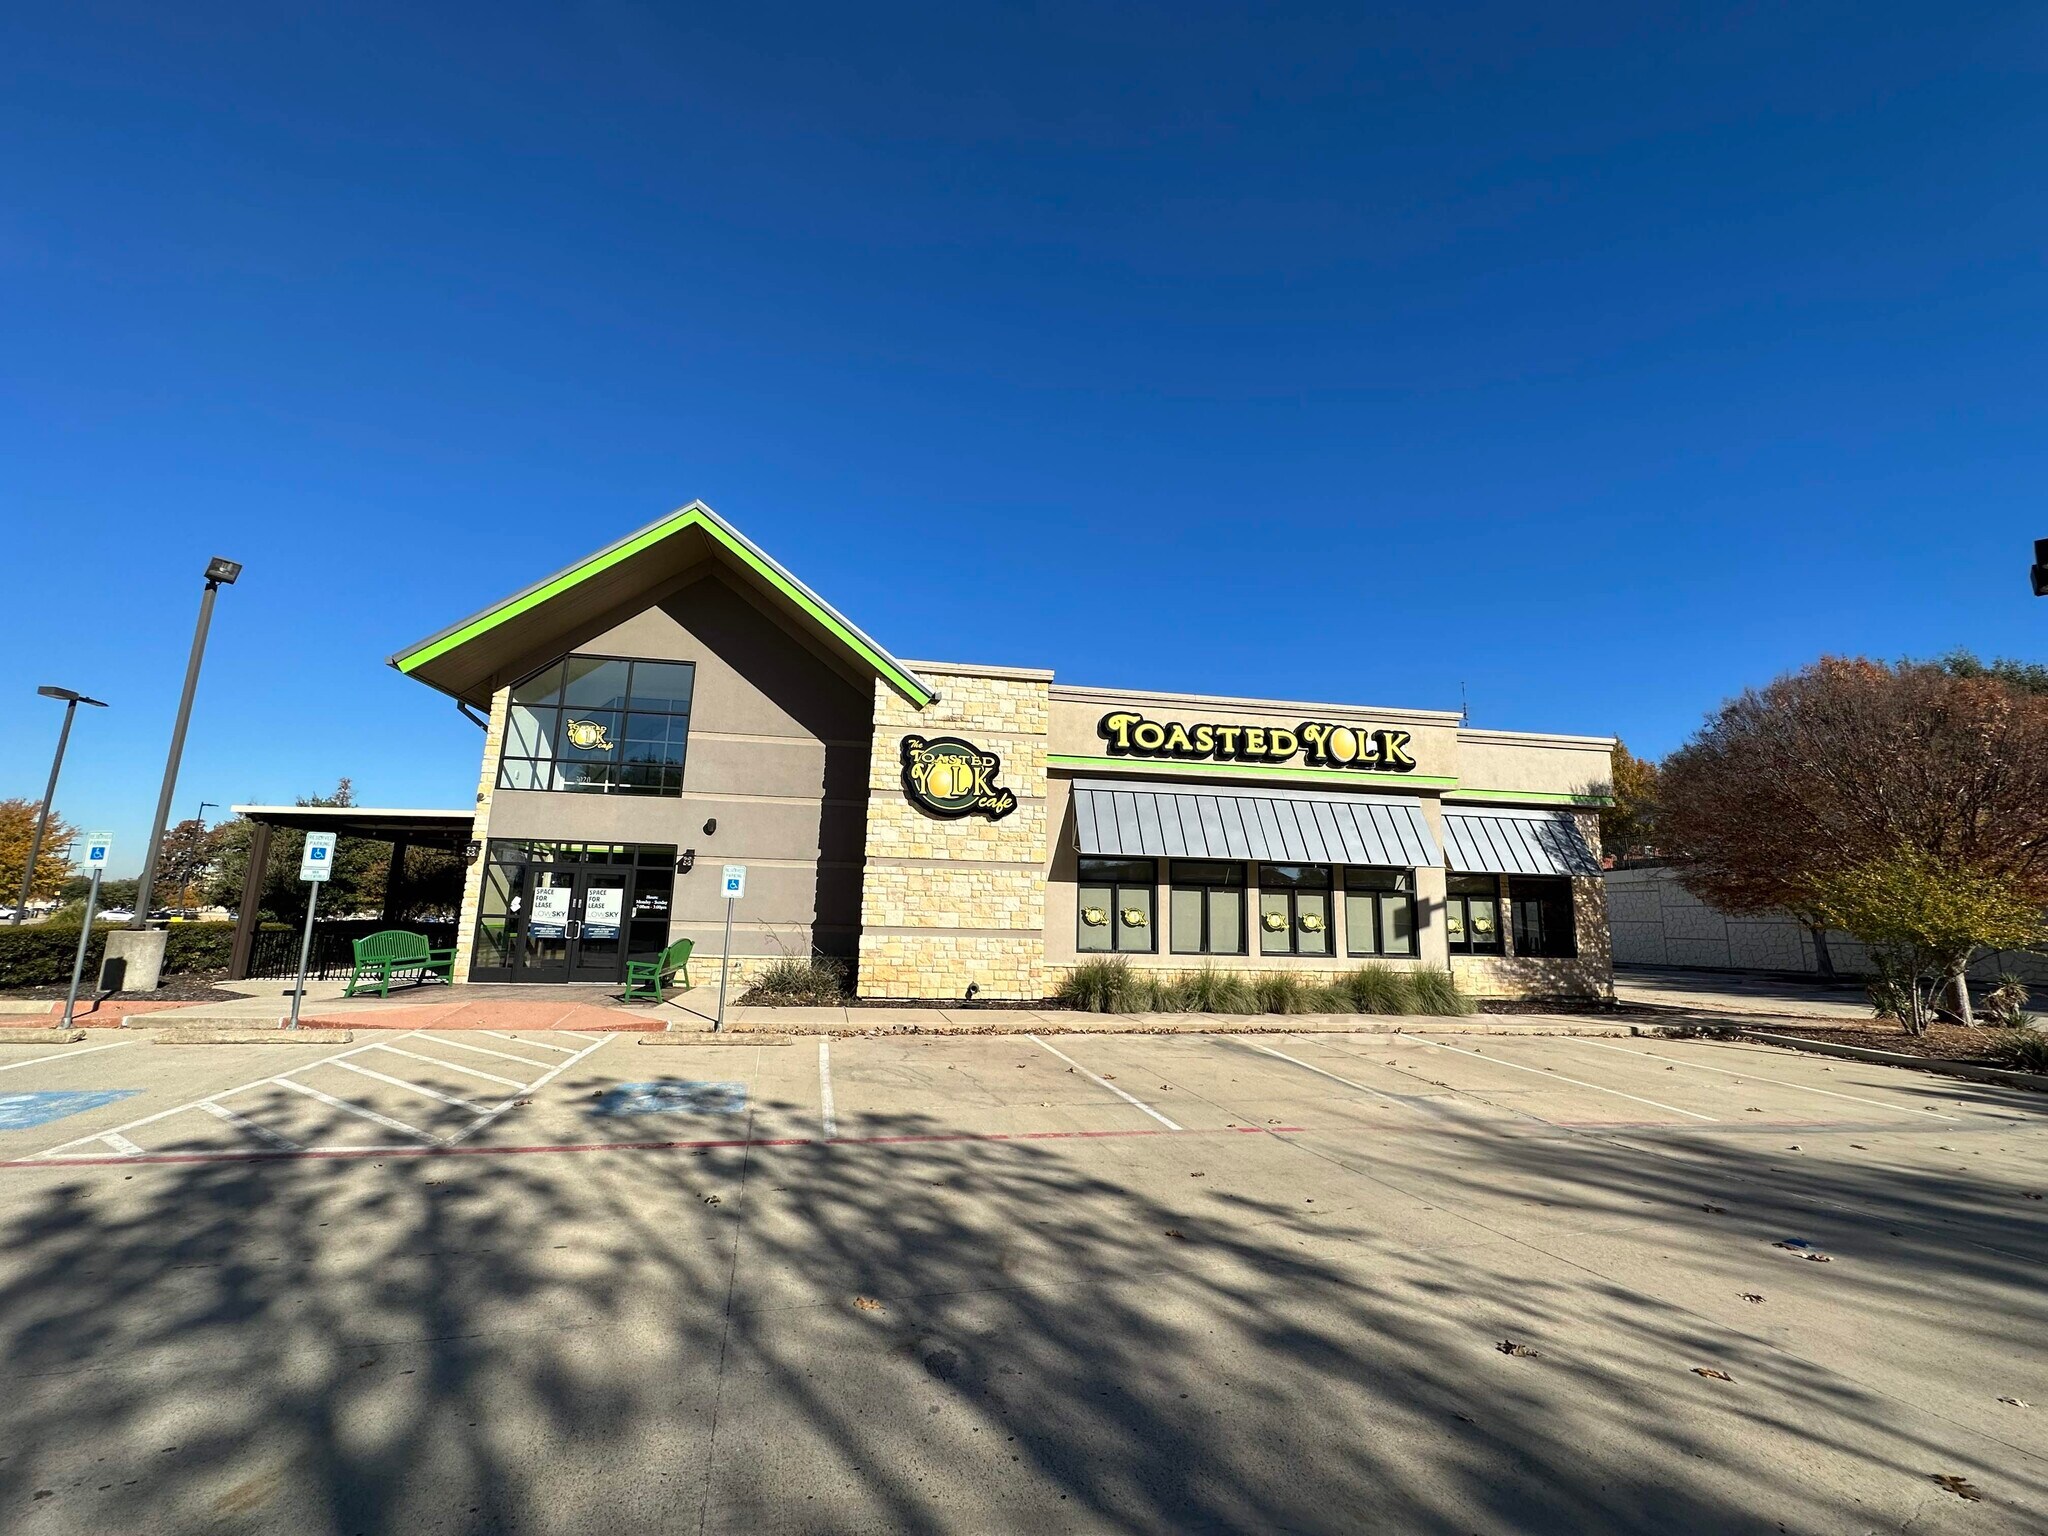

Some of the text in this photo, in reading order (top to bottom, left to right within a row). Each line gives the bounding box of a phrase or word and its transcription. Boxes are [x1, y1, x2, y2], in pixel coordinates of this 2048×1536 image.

[907, 739, 924, 748] The
[1105, 713, 1416, 765] TOASTED YOLK
[910, 749, 996, 767] TOASTED
[911, 763, 996, 798] YOLK
[978, 793, 1013, 813] cafe
[536, 888, 555, 896] SPACE
[535, 894, 548, 902] FOR
[534, 901, 553, 909] LEASE
[587, 902, 606, 910] LEASE
